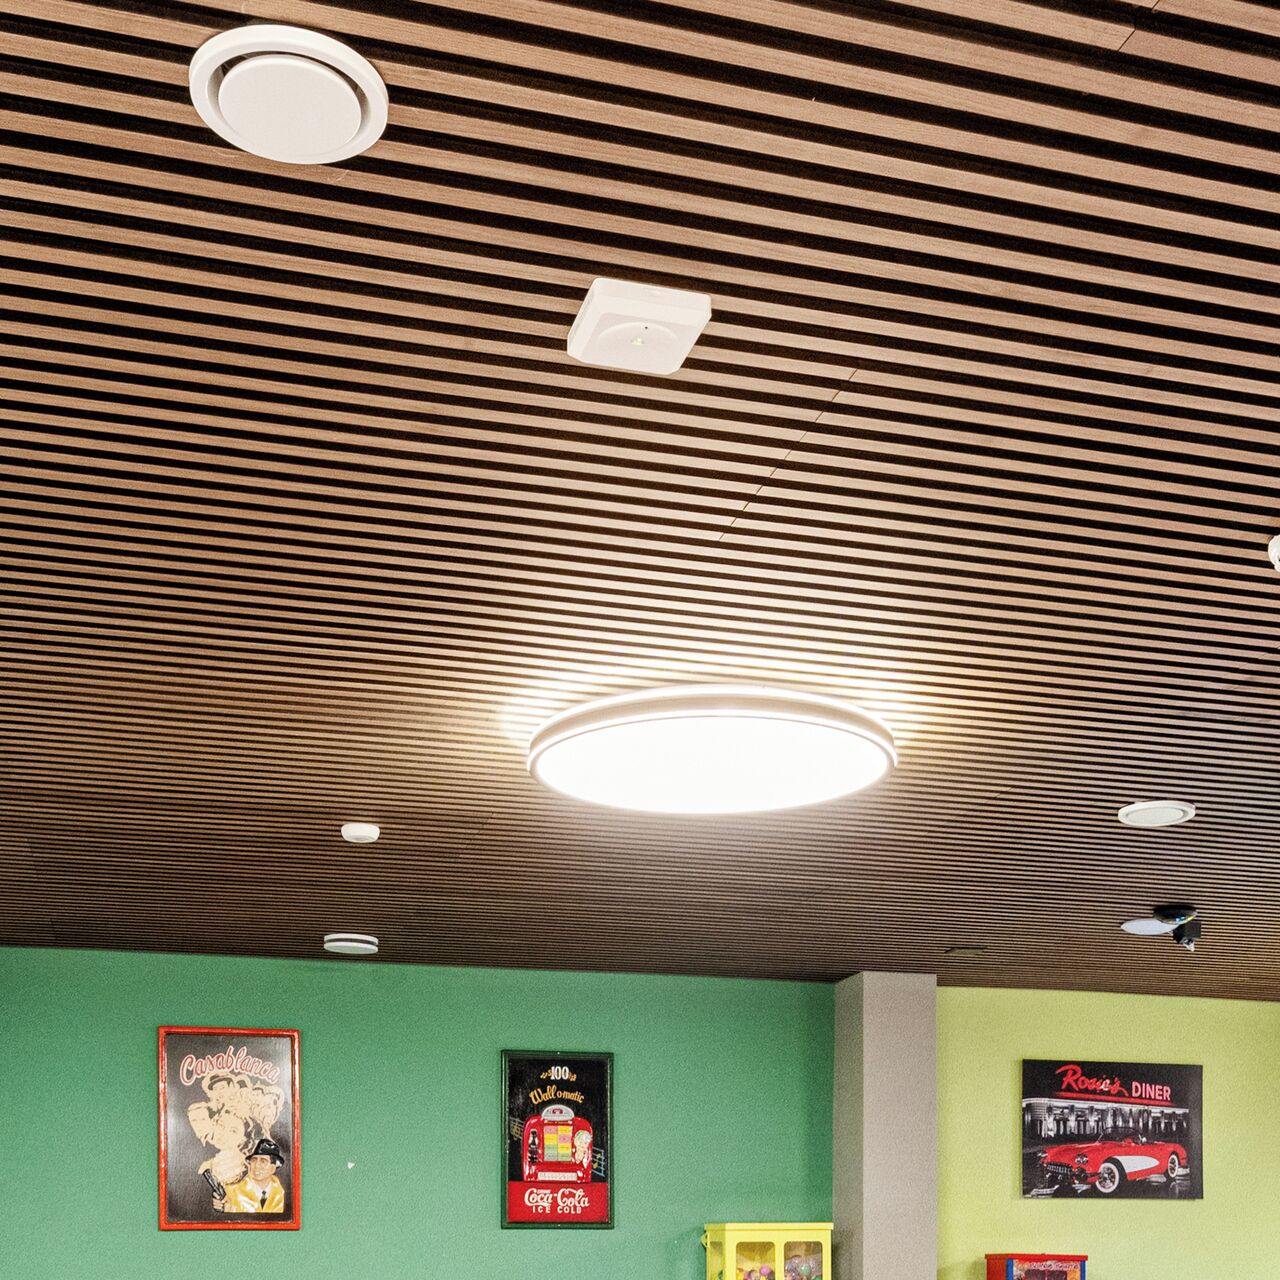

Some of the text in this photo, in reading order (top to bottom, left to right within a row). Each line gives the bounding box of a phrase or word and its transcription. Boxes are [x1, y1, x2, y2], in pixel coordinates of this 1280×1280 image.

[179, 1045, 280, 1086] Casablanca
[550, 1066, 570, 1080] 100
[1055, 1064, 1171, 1100] Rosie's DINER
[528, 1084, 558, 1105] Wall
[524, 1187, 590, 1207] Coca-Cola
[532, 1205, 582, 1214] ICE COLD
